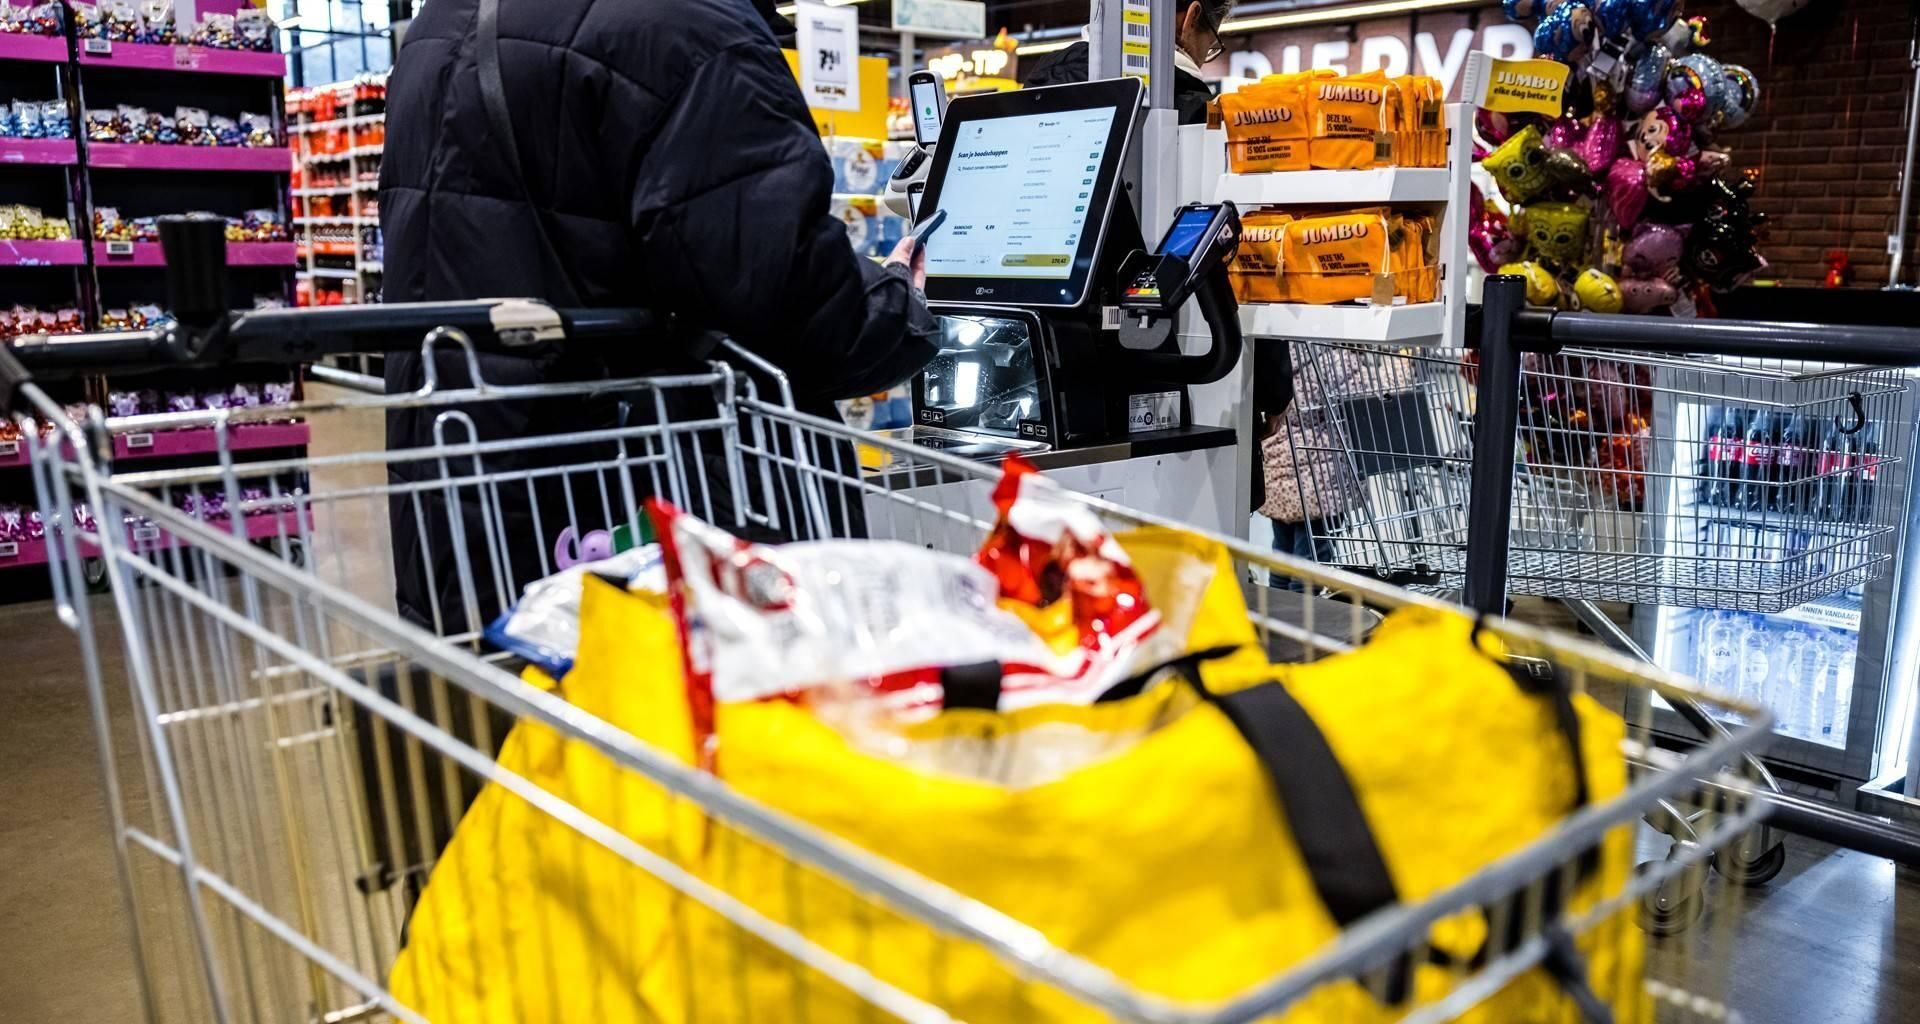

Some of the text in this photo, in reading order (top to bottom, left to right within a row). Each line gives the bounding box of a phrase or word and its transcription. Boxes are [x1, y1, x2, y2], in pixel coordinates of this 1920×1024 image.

[1497, 72, 1560, 91] JUMBO
[1318, 84, 1382, 105] JUMBO
[1494, 87, 1548, 101] elke dag beter
[1233, 107, 1292, 127] JUMBO
[1326, 113, 1352, 123] DEZE TAS
[1326, 123, 1333, 131] IS
[1333, 124, 1348, 132] 100%
[974, 150, 1008, 158] boodschappen
[1247, 145, 1253, 155] IS
[1253, 145, 1266, 154] 100%
[1239, 226, 1283, 243] MBO
[1302, 222, 1368, 245] JUMBO
[1318, 253, 1345, 263] DEZE TAS
[1328, 262, 1343, 270] 100%
